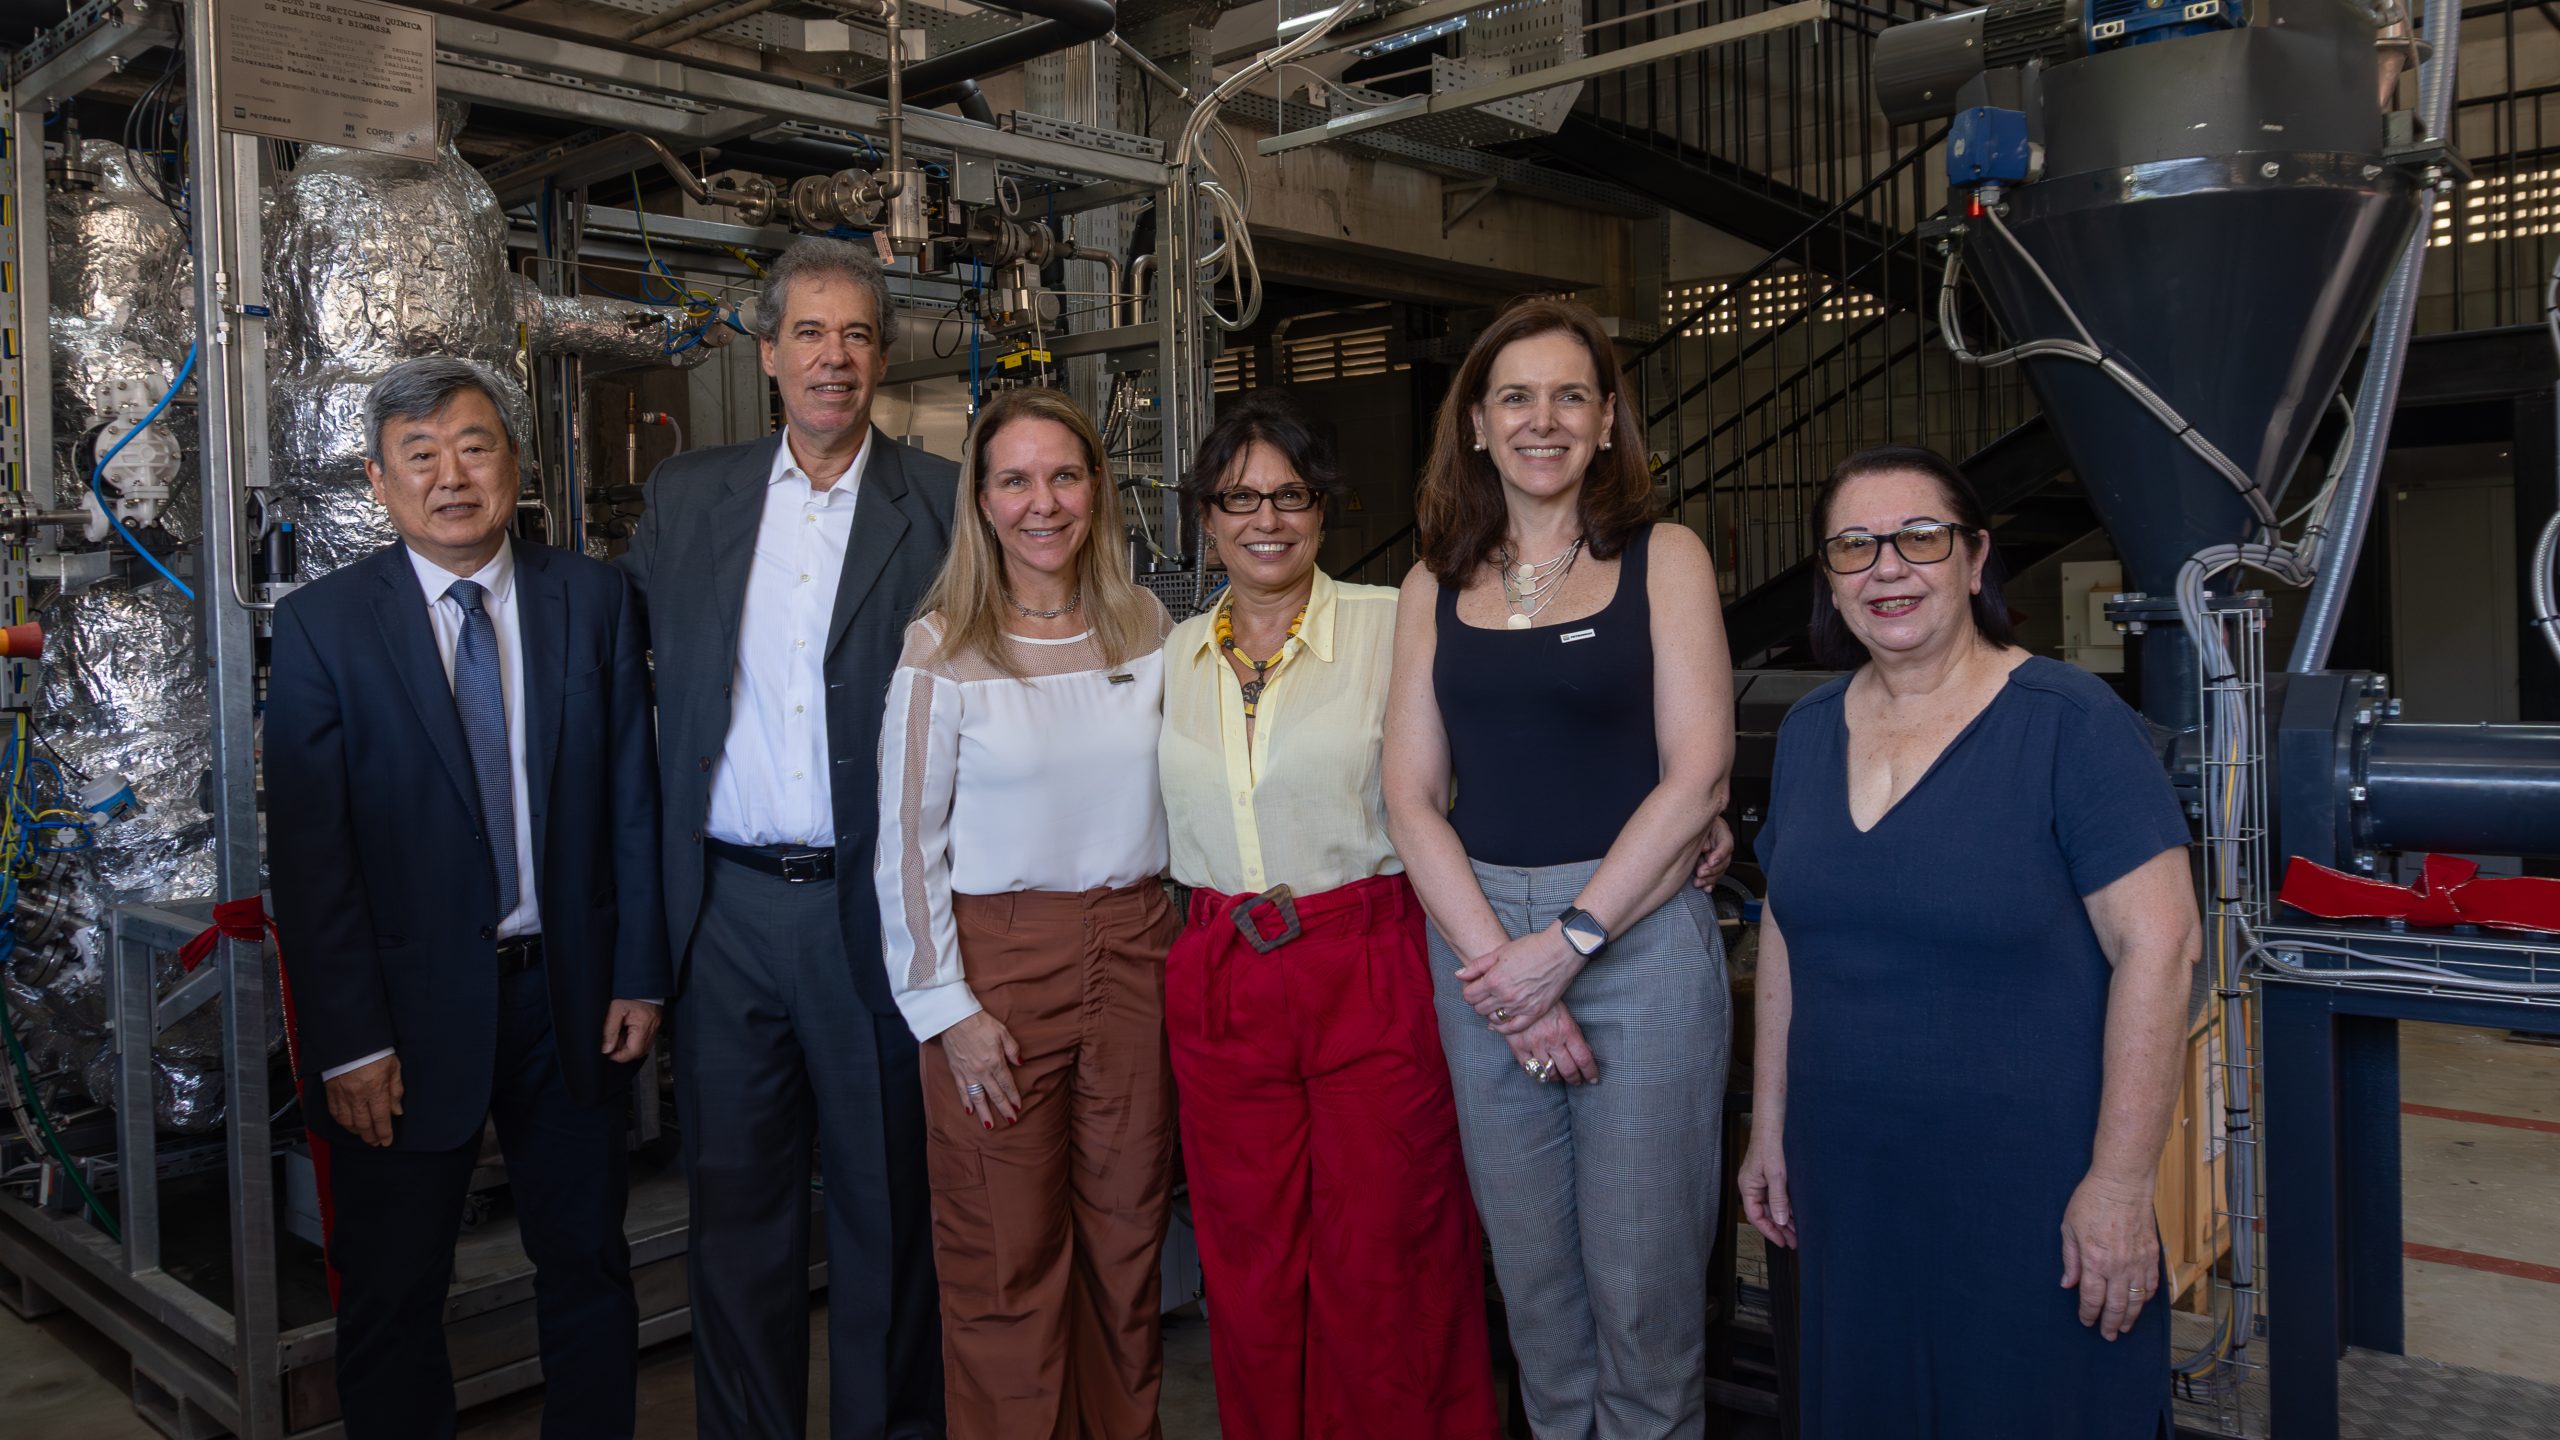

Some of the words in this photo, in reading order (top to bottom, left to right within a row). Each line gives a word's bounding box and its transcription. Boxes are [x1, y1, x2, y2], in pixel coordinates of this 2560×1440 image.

[264, 2, 277, 11] DE
[348, 20, 392, 35] BIOMASSA
[309, 1, 321, 10] DE
[326, 5, 380, 22] RECICLAGEM
[366, 127, 394, 138] COPPE
